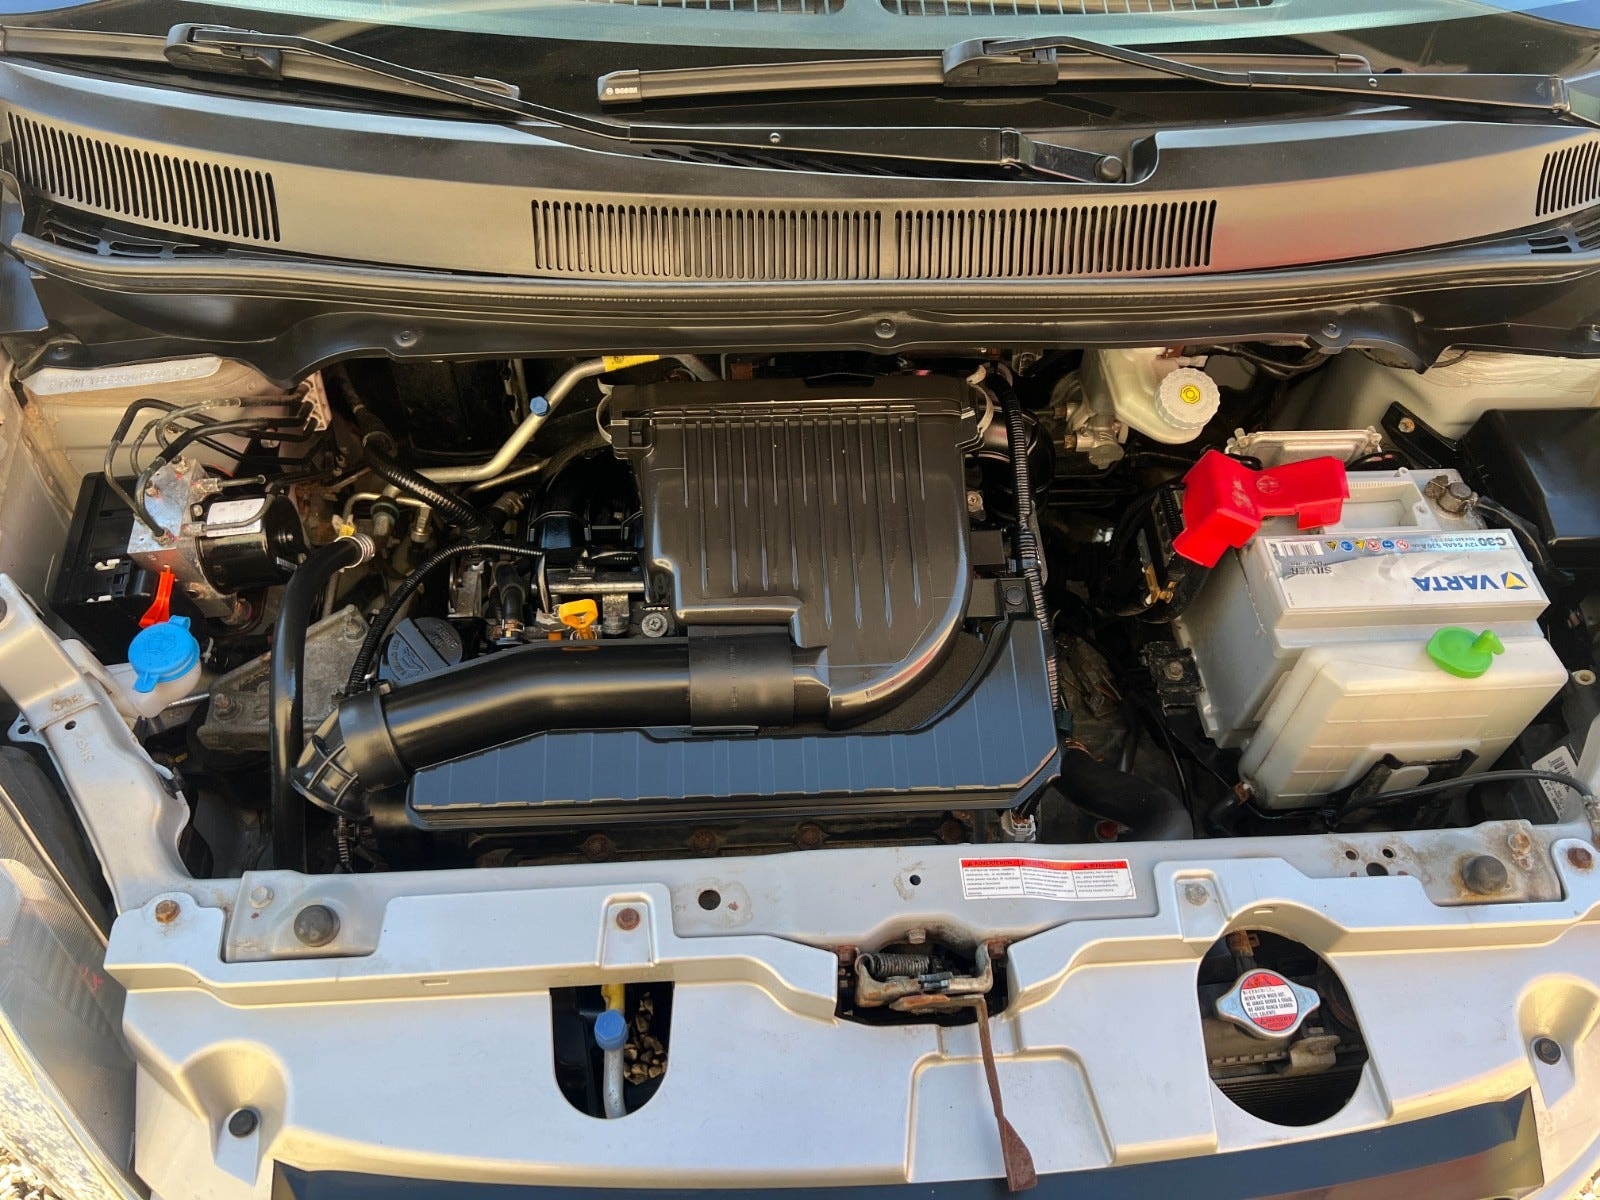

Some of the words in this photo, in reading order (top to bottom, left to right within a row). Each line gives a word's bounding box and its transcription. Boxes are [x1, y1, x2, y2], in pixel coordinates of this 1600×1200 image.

[1478, 536, 1507, 547] C30
[1291, 565, 1332, 575] SILVER
[1411, 574, 1500, 591] VARTA
